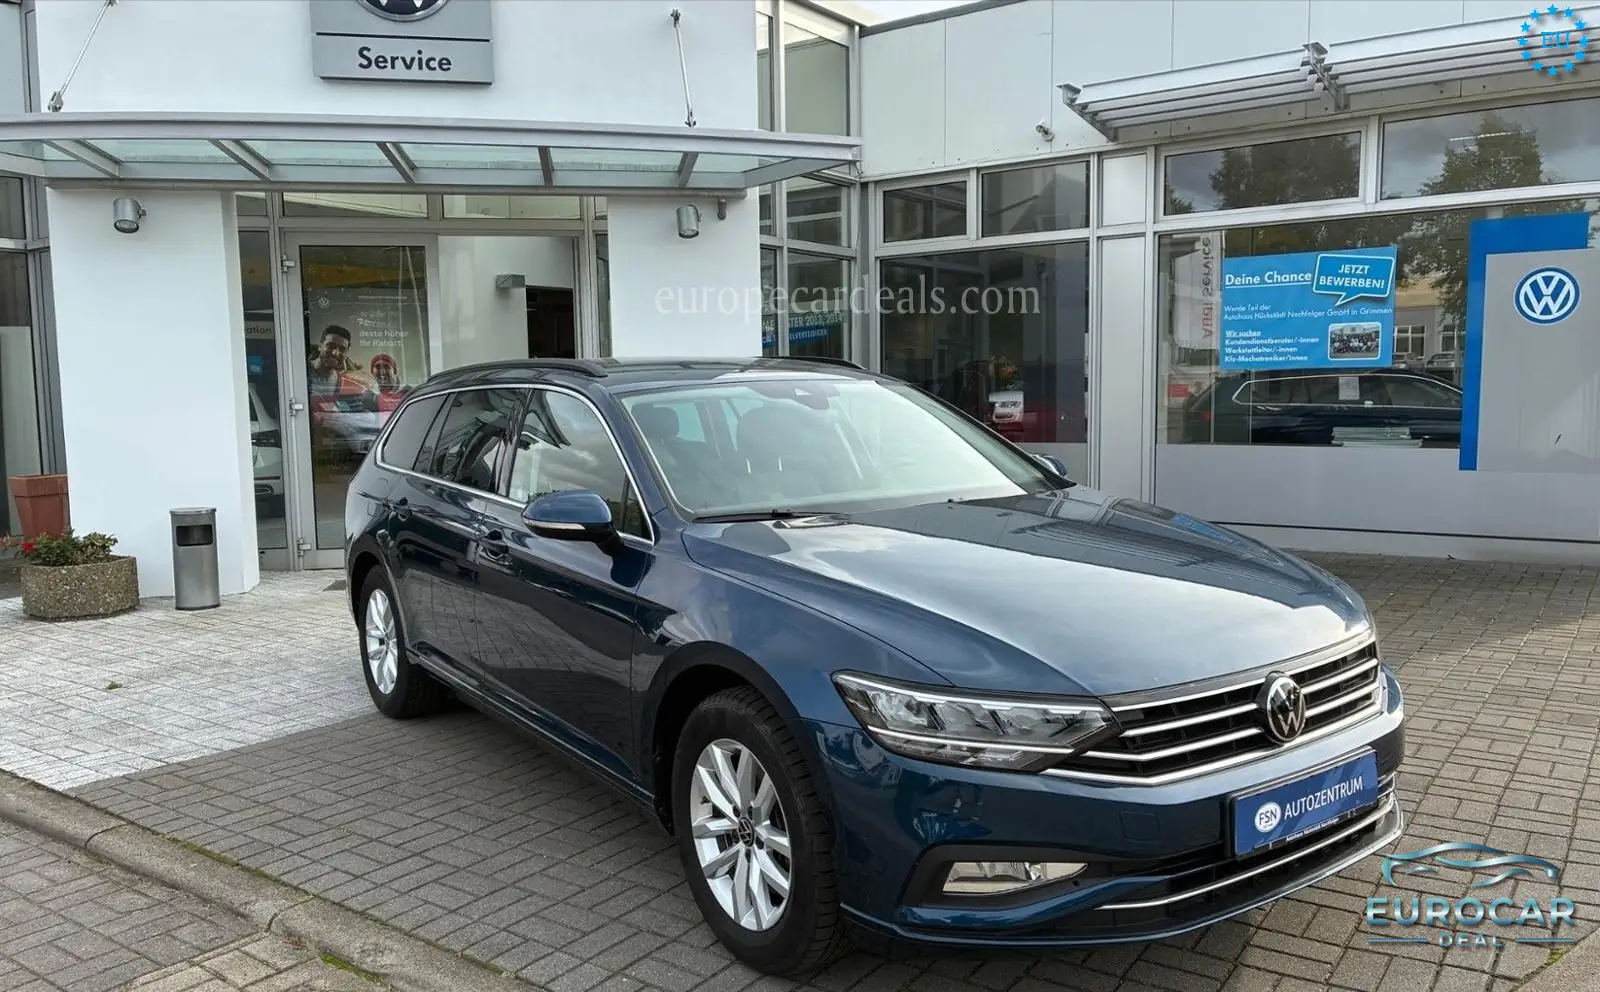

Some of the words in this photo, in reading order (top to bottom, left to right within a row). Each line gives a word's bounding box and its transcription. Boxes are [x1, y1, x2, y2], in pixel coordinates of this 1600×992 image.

[358, 46, 452, 71] Service
[1338, 264, 1370, 275] JETZT
[1225, 273, 1260, 286] Deine
[1264, 270, 1312, 284] Chance
[1319, 276, 1385, 289] BEWERBEN!
[1260, 303, 1271, 311] der
[1326, 308, 1350, 317] GmbH
[1351, 308, 1358, 316] in
[1360, 307, 1392, 315] Grimmen
[1259, 808, 1277, 825] FSN
[1284, 776, 1363, 820] AUTOZENTRUM
